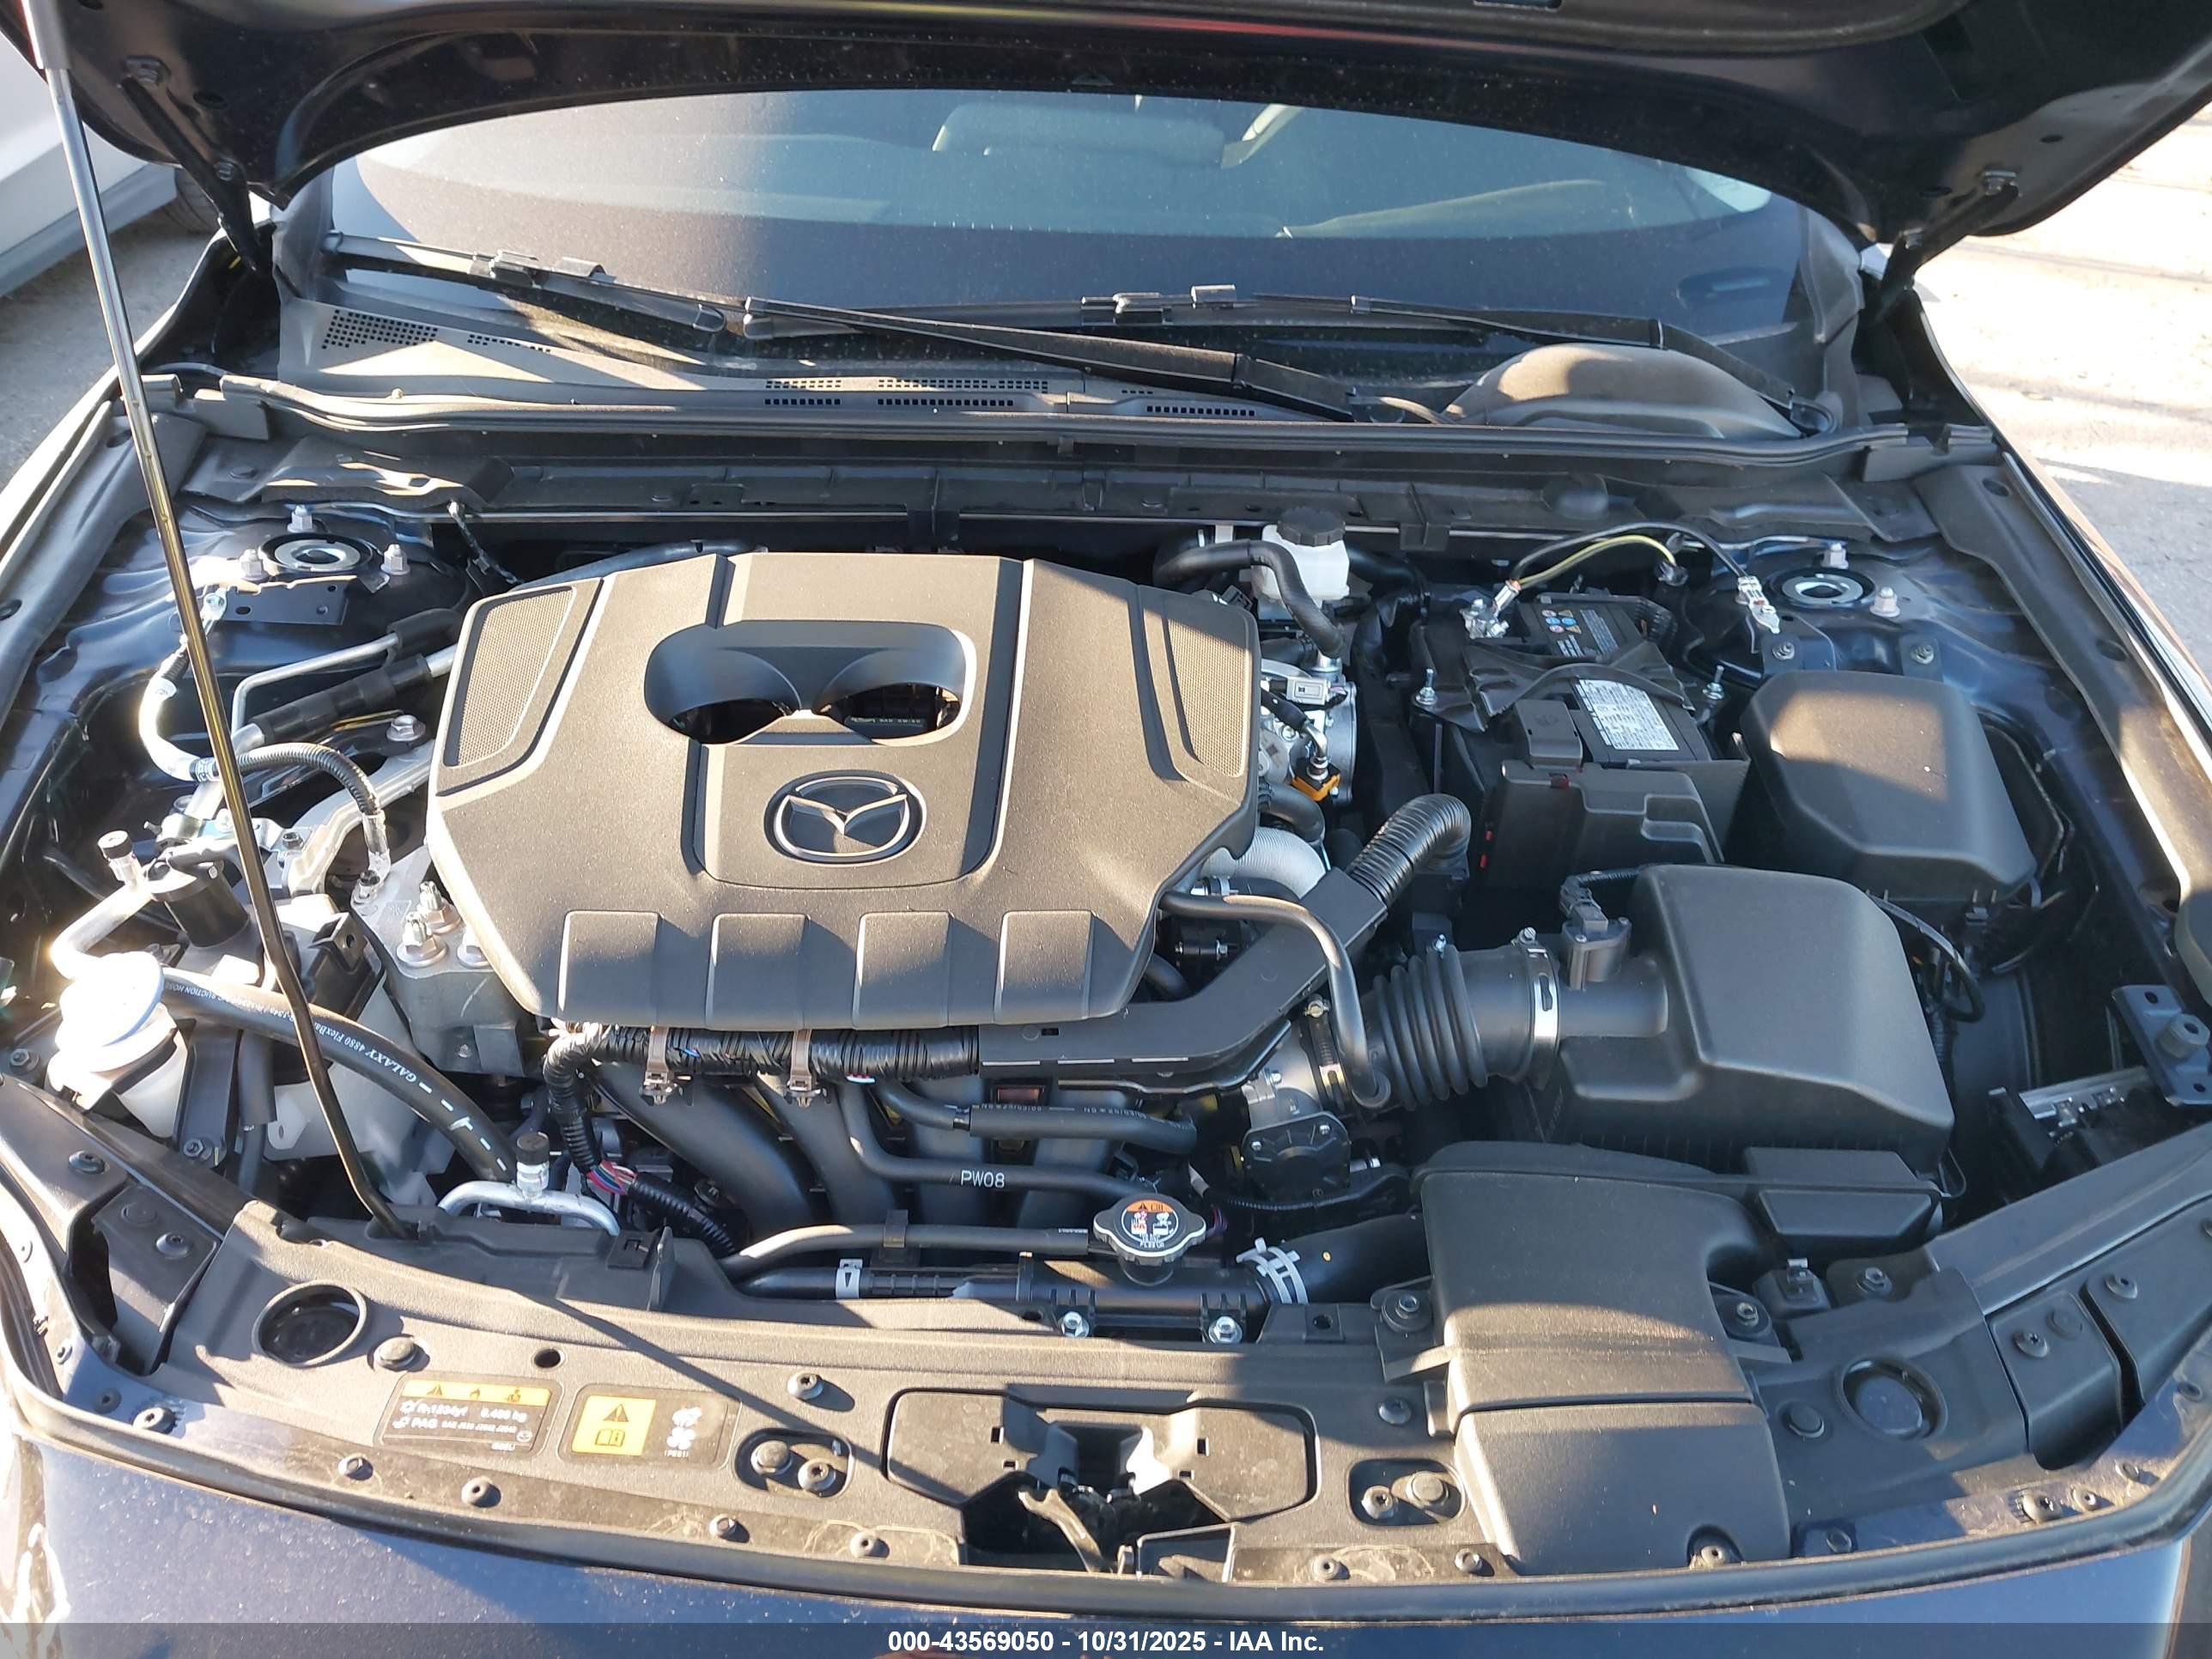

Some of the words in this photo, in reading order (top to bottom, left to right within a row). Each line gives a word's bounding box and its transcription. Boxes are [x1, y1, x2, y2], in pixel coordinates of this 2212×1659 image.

[344, 1036, 366, 1052] 4880
[365, 1048, 417, 1083] GALAXY
[960, 1169, 1006, 1188] PW08
[410, 1416, 439, 1430] PAG
